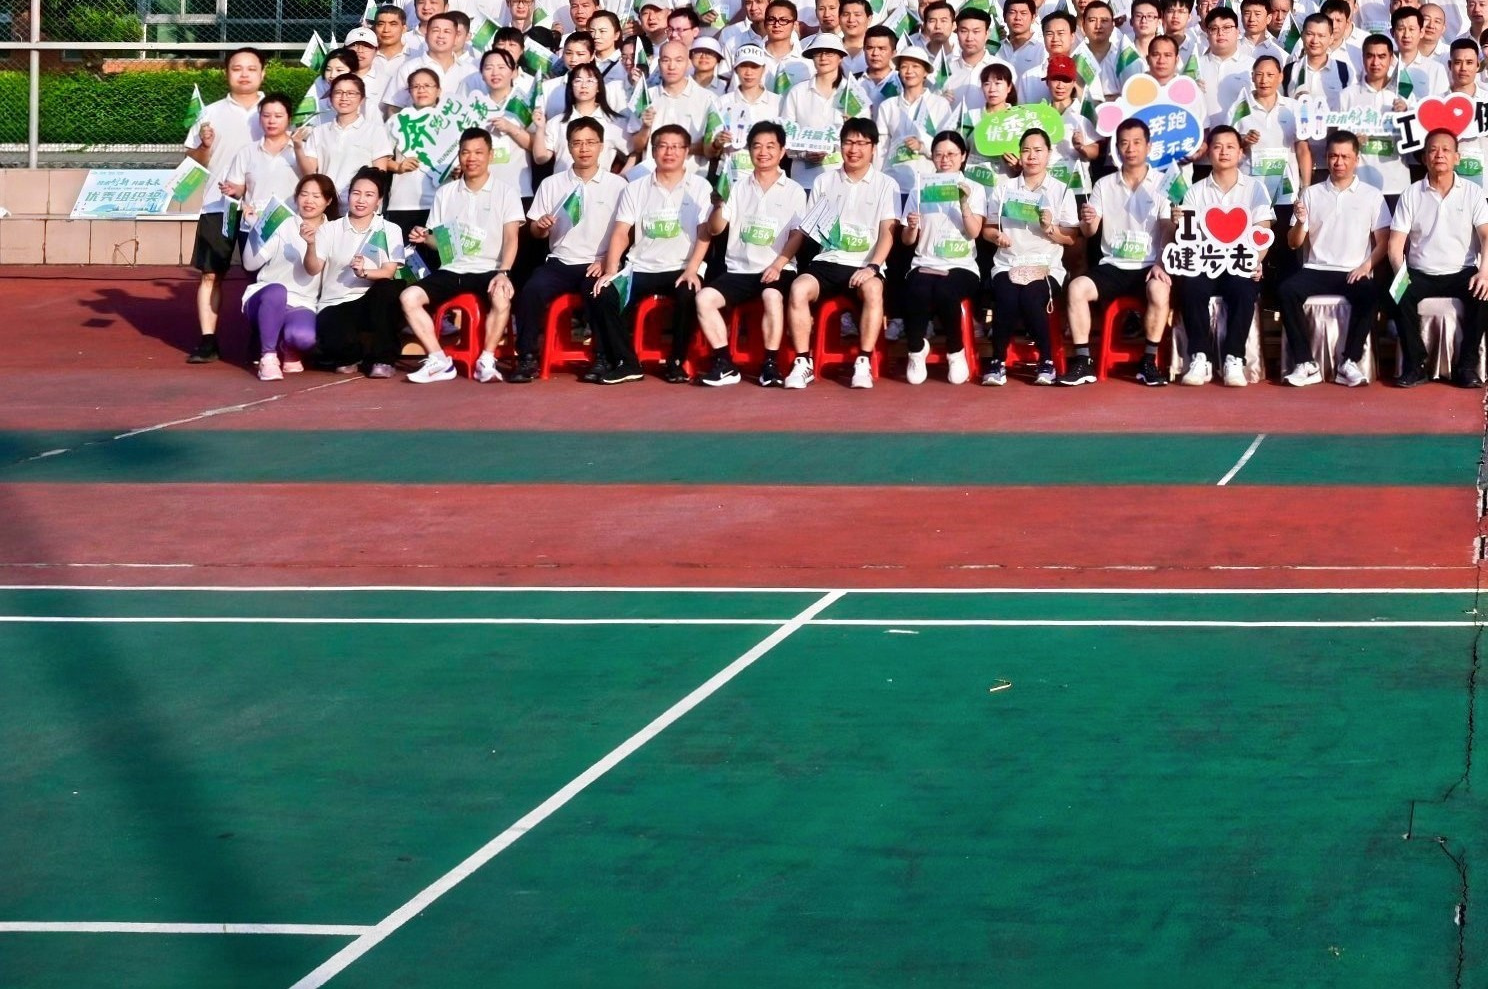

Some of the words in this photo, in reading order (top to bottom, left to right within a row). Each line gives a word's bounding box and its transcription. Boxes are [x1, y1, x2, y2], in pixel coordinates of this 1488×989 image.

[1397, 114, 1421, 150] I
[1463, 160, 1479, 169] 192
[975, 170, 992, 179] 017
[84, 191, 162, 202] 优秀组织奖
[658, 221, 676, 233] 167
[1181, 210, 1197, 240] I
[751, 227, 770, 240] 256
[845, 235, 863, 247] 129
[949, 242, 966, 252] 124
[1123, 243, 1140, 253] 099
[1167, 243, 1254, 273] 健步走
